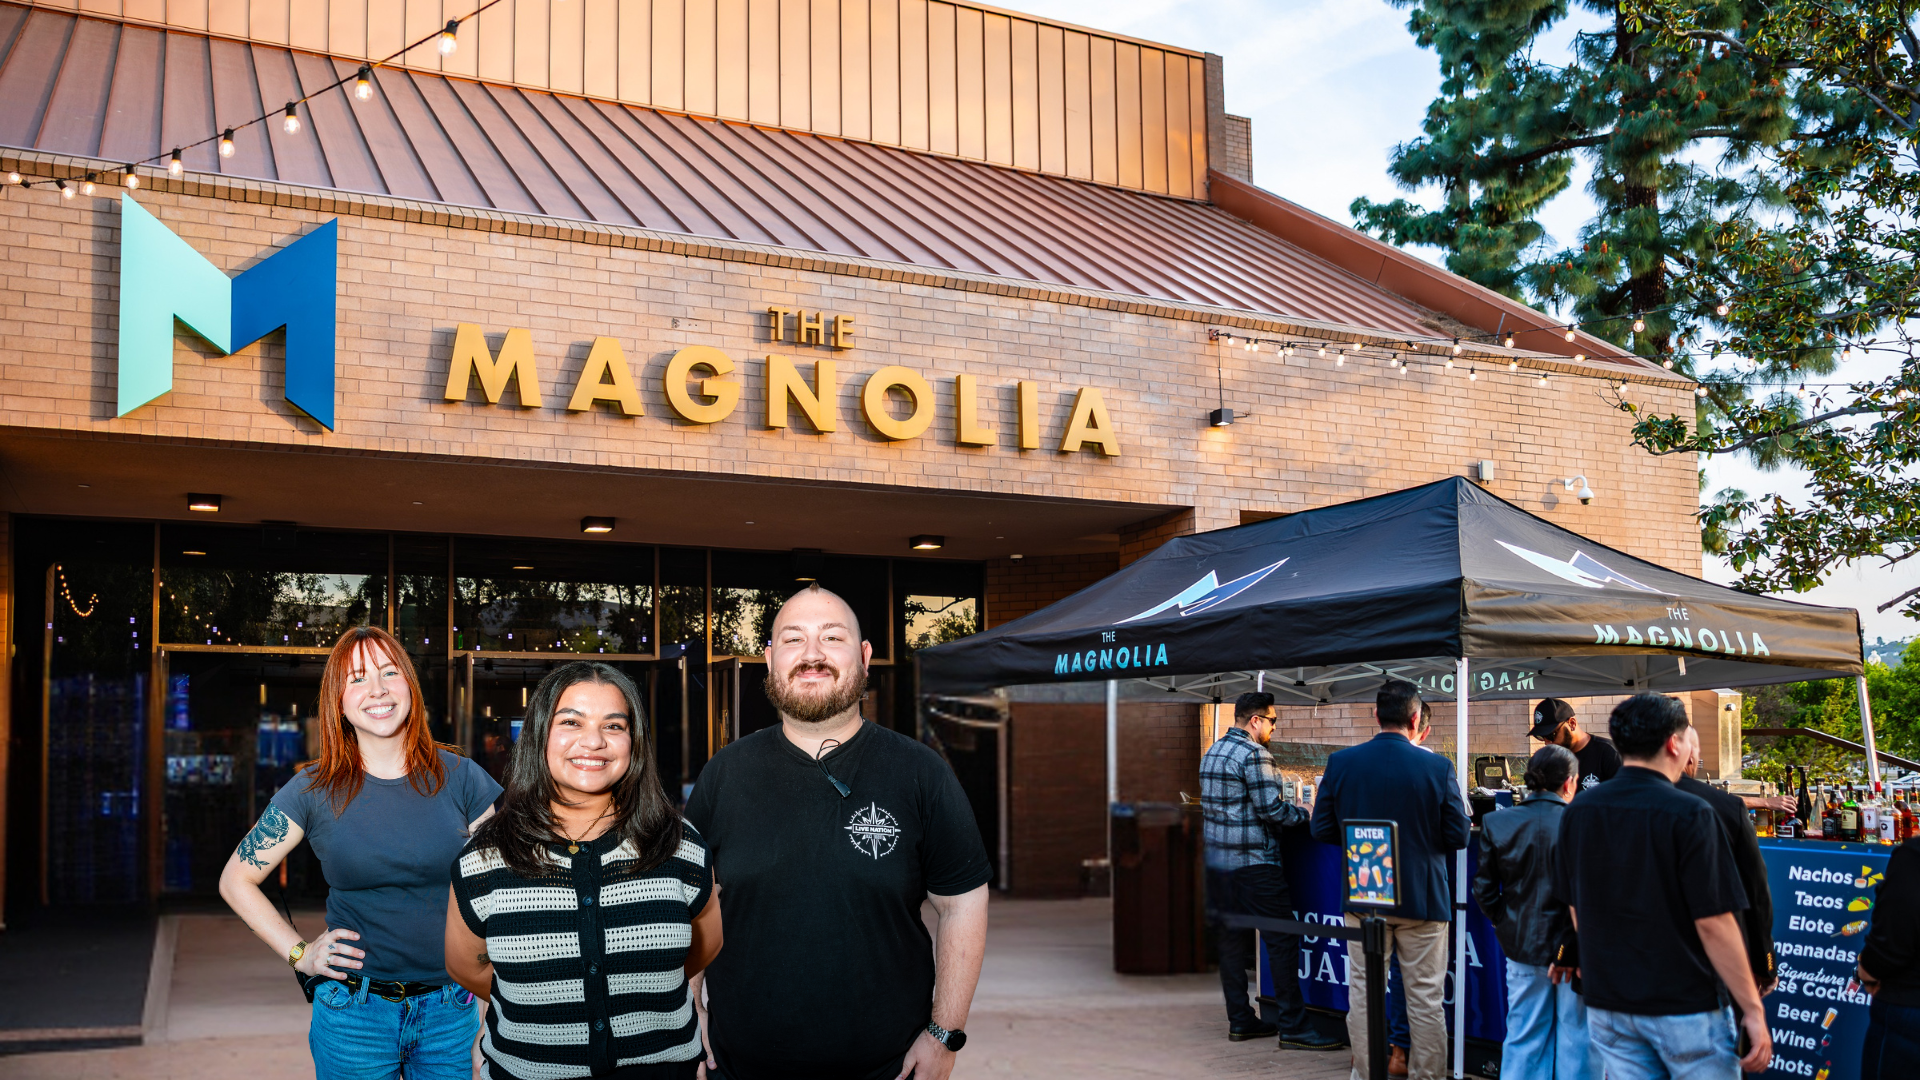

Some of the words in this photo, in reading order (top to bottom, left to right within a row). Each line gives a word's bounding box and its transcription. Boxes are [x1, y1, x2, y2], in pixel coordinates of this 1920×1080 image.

[767, 306, 855, 350] THE
[445, 322, 1121, 458] MAGNOLIA
[1666, 607, 1689, 621] THE
[1102, 631, 1116, 643] THE
[1593, 624, 1770, 656] MAGNOLIA
[1054, 643, 1168, 674] MAGNOLIA
[1355, 828, 1384, 839] ENTER
[1789, 865, 1853, 885] Nachos
[1795, 891, 1844, 909] Tacos
[1789, 915, 1834, 934] Elote
[1773, 941, 1856, 963] mpanadas
[1777, 962, 1845, 985] Signature
[1777, 1003, 1819, 1023] Beer
[1771, 1028, 1816, 1050] Wine
